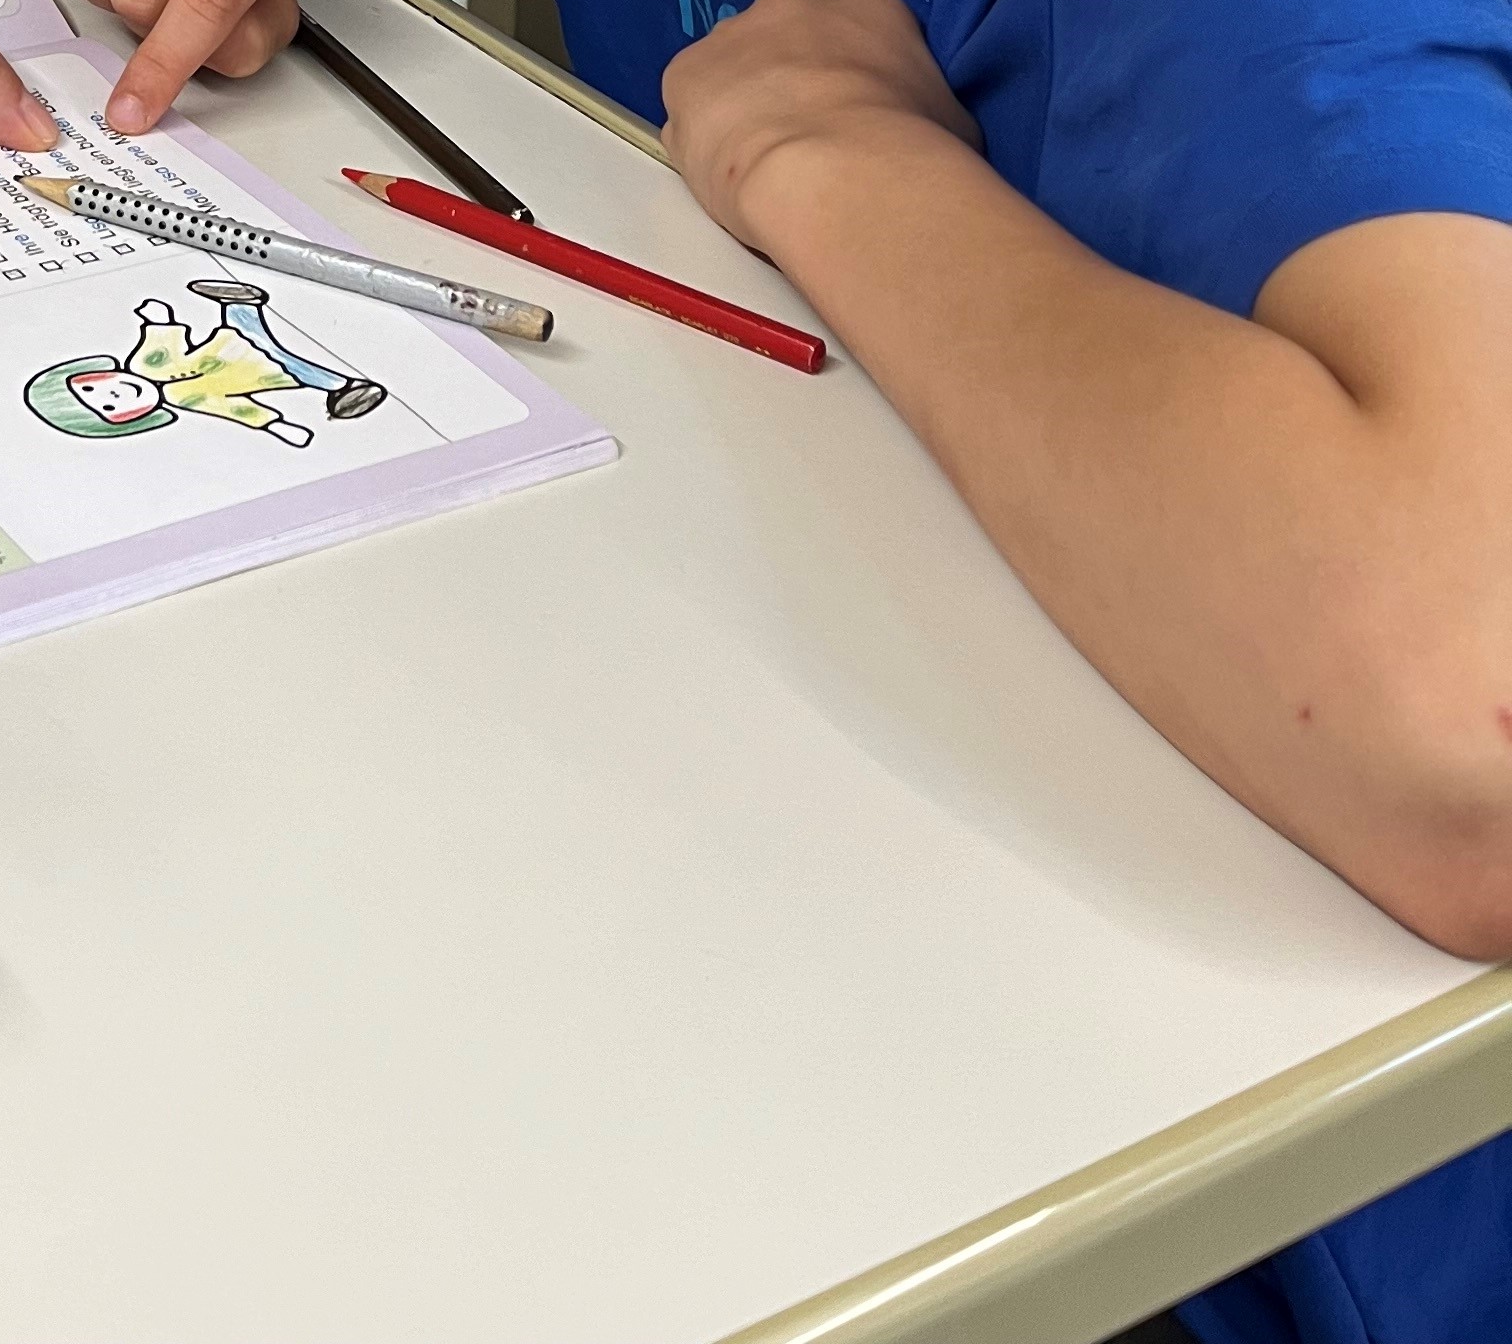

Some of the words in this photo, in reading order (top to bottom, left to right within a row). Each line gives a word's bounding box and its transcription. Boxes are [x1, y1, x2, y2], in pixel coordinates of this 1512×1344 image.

[90, 150, 115, 166] ein
[127, 145, 159, 166] eine
[107, 165, 143, 188] liegt
[154, 166, 187, 188] Lisa
[183, 186, 221, 214] Male
[26, 203, 59, 230] trägt
[14, 233, 45, 256] Ihre
[53, 227, 81, 248] Sie
